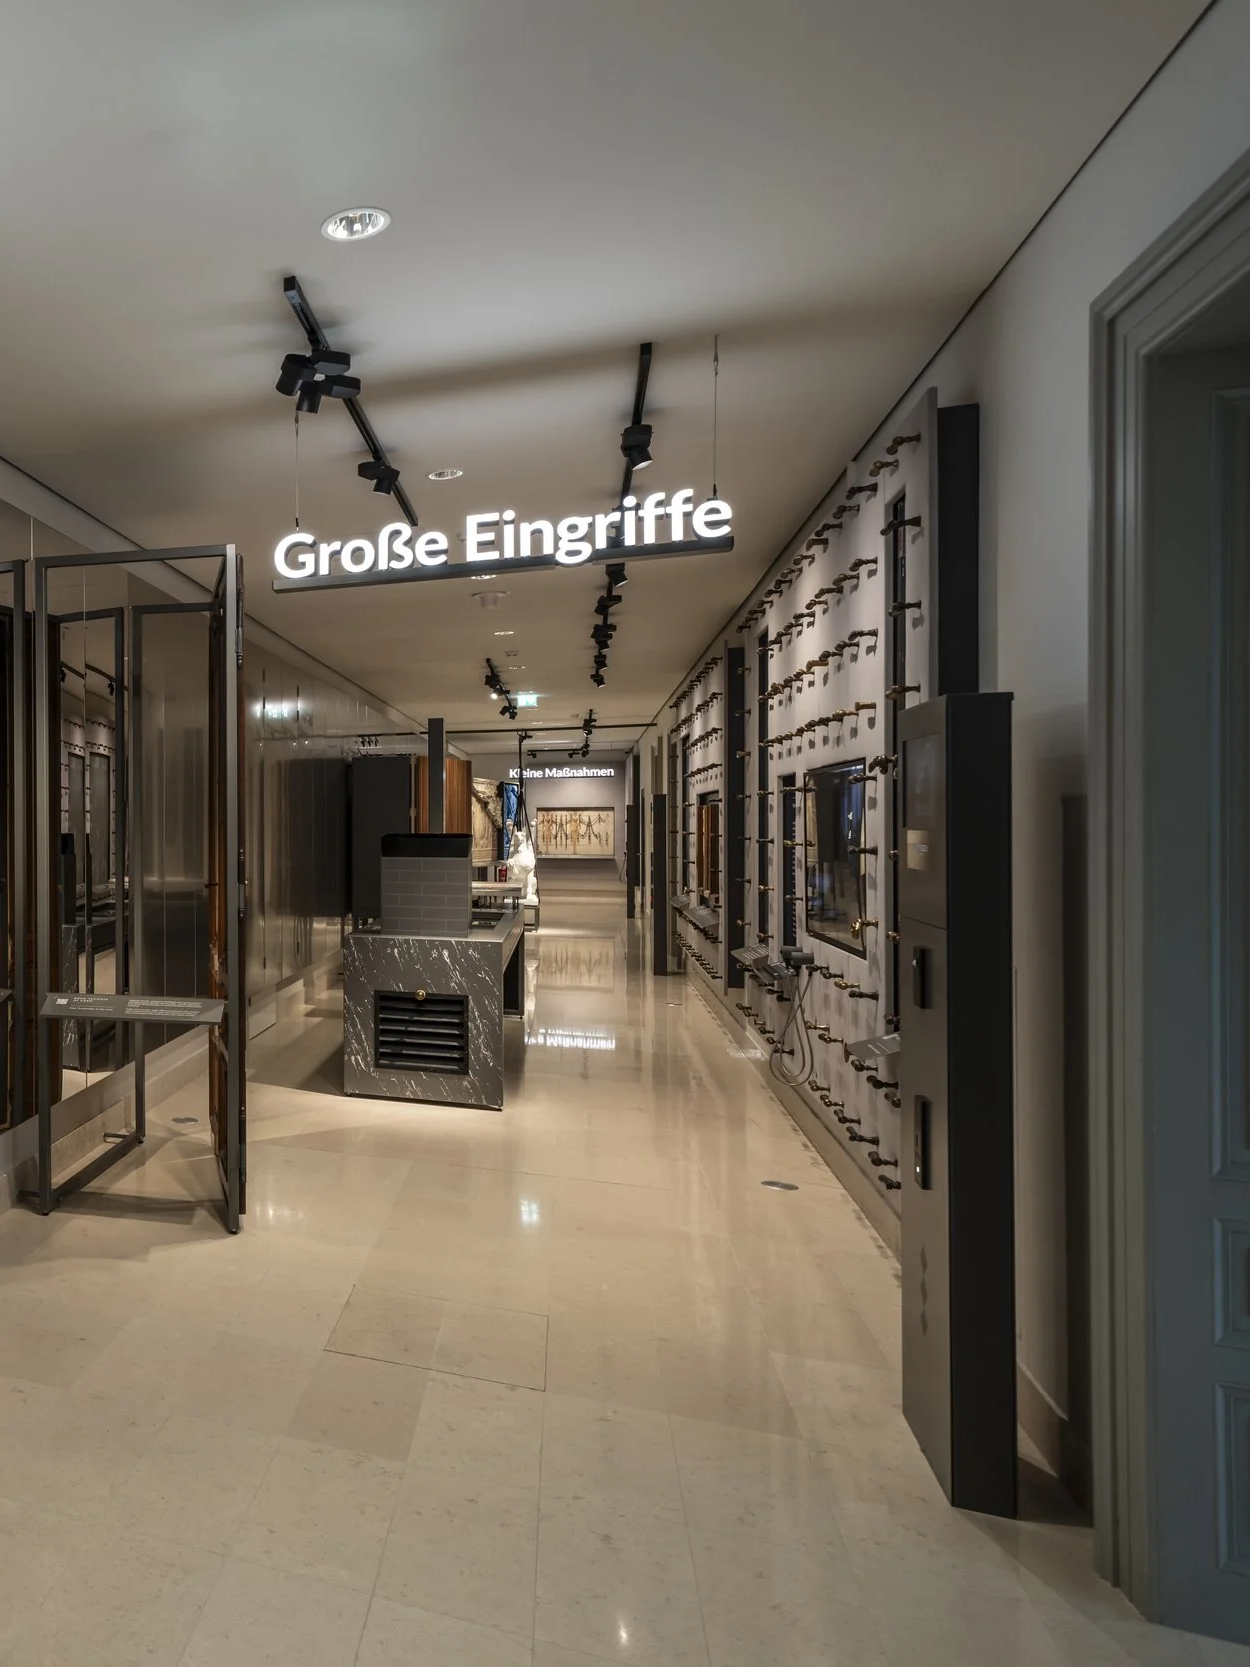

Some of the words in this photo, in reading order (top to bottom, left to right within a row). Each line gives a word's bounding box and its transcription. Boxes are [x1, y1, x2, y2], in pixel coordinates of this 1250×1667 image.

[274, 522, 448, 578] Große
[466, 488, 733, 565] Eingriffe
[545, 767, 615, 778] Maßnahmen
